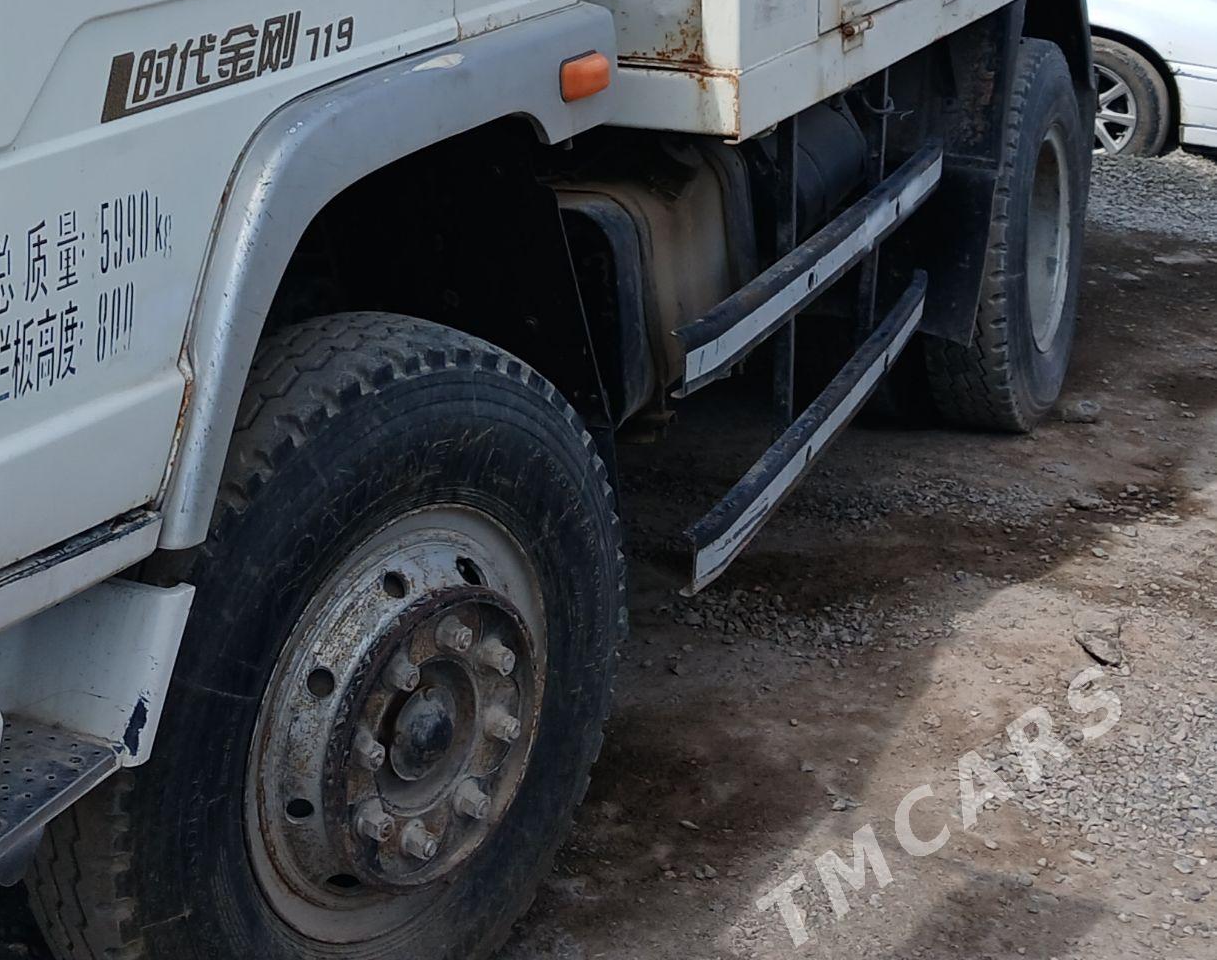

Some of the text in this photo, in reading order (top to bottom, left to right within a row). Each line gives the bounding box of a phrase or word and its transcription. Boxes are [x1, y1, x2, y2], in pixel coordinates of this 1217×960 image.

[132, 10, 354, 105] 时代金刚 719
